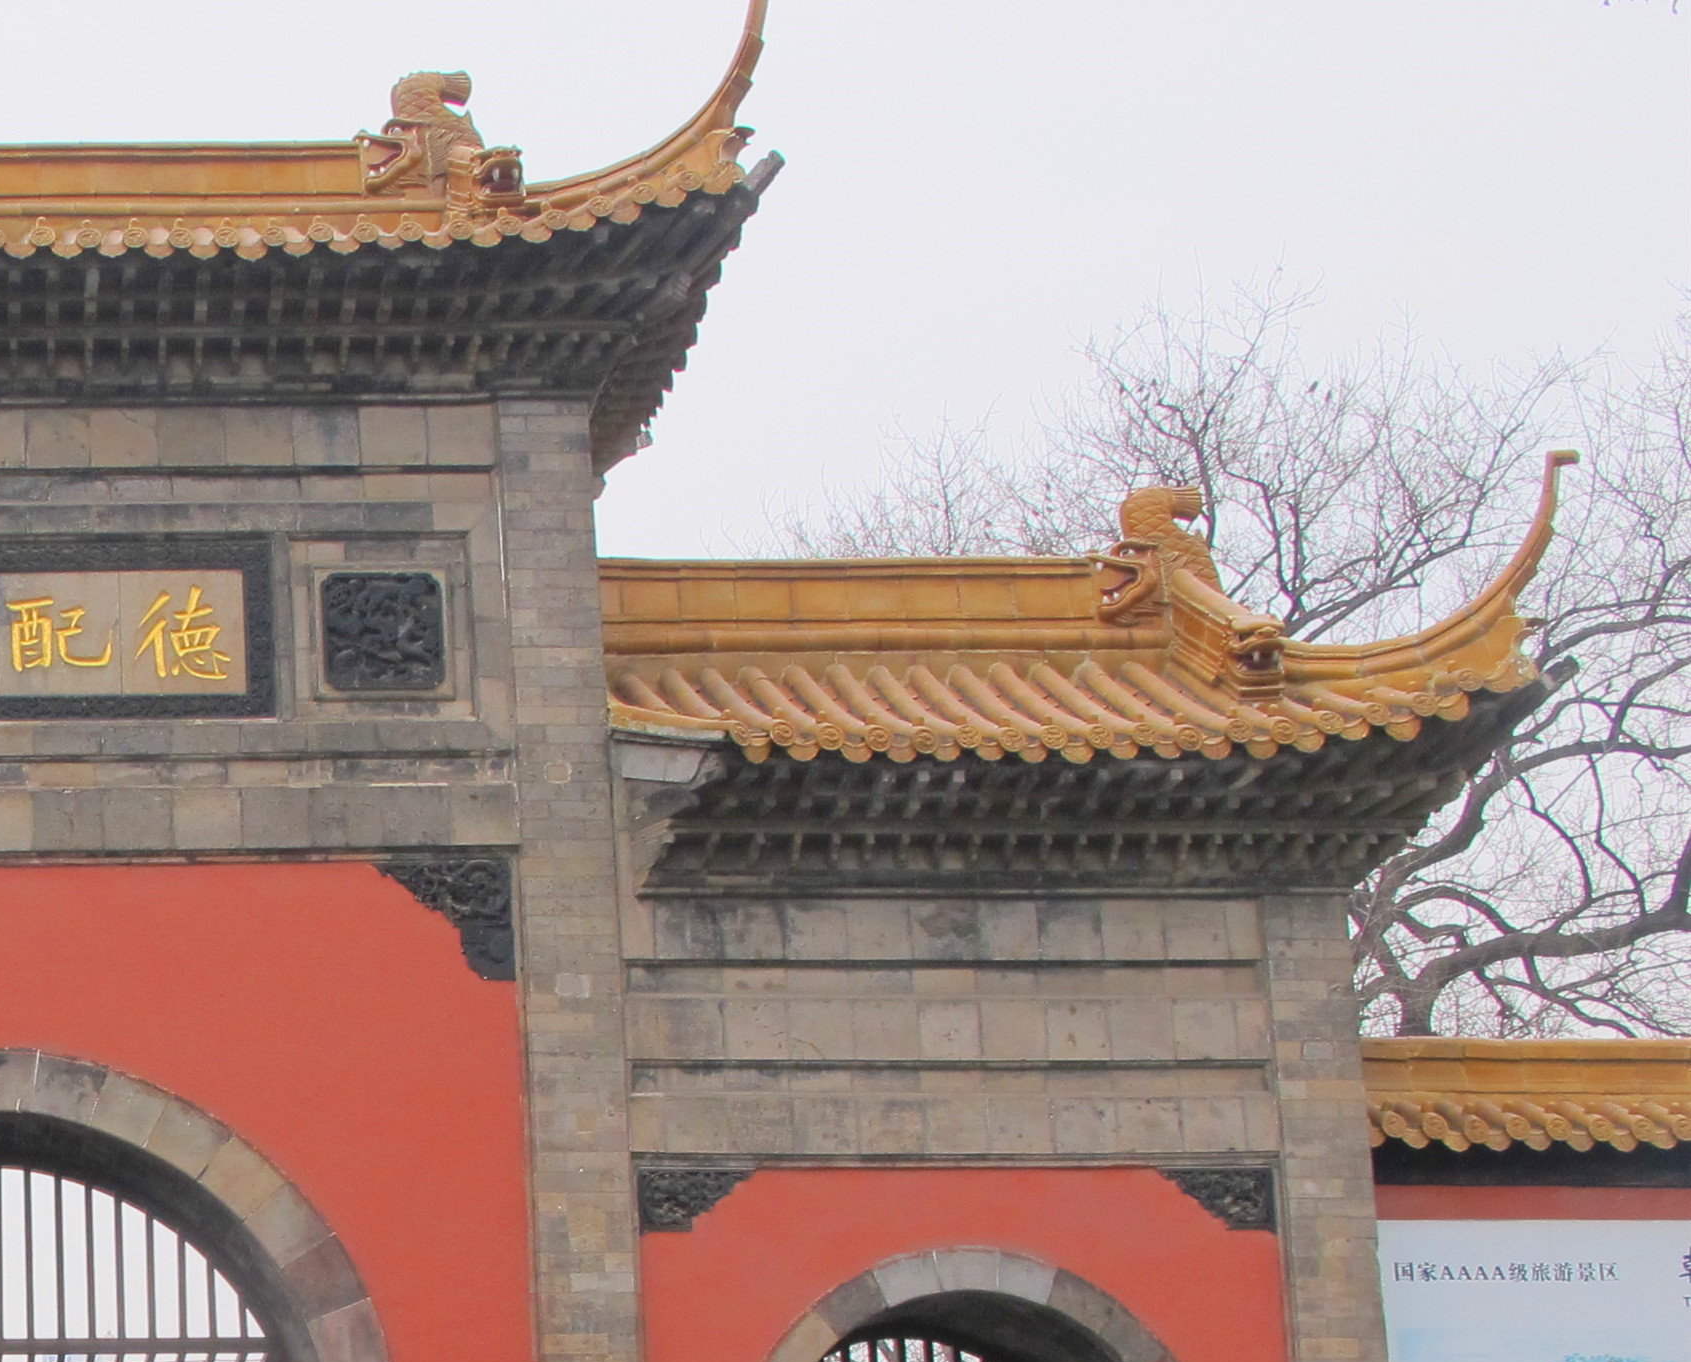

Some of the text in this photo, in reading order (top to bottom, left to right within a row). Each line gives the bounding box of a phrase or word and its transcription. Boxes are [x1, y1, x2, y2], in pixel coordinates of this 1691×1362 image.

[1393, 1262, 1620, 1282] 国家AAAA级旅游景区
